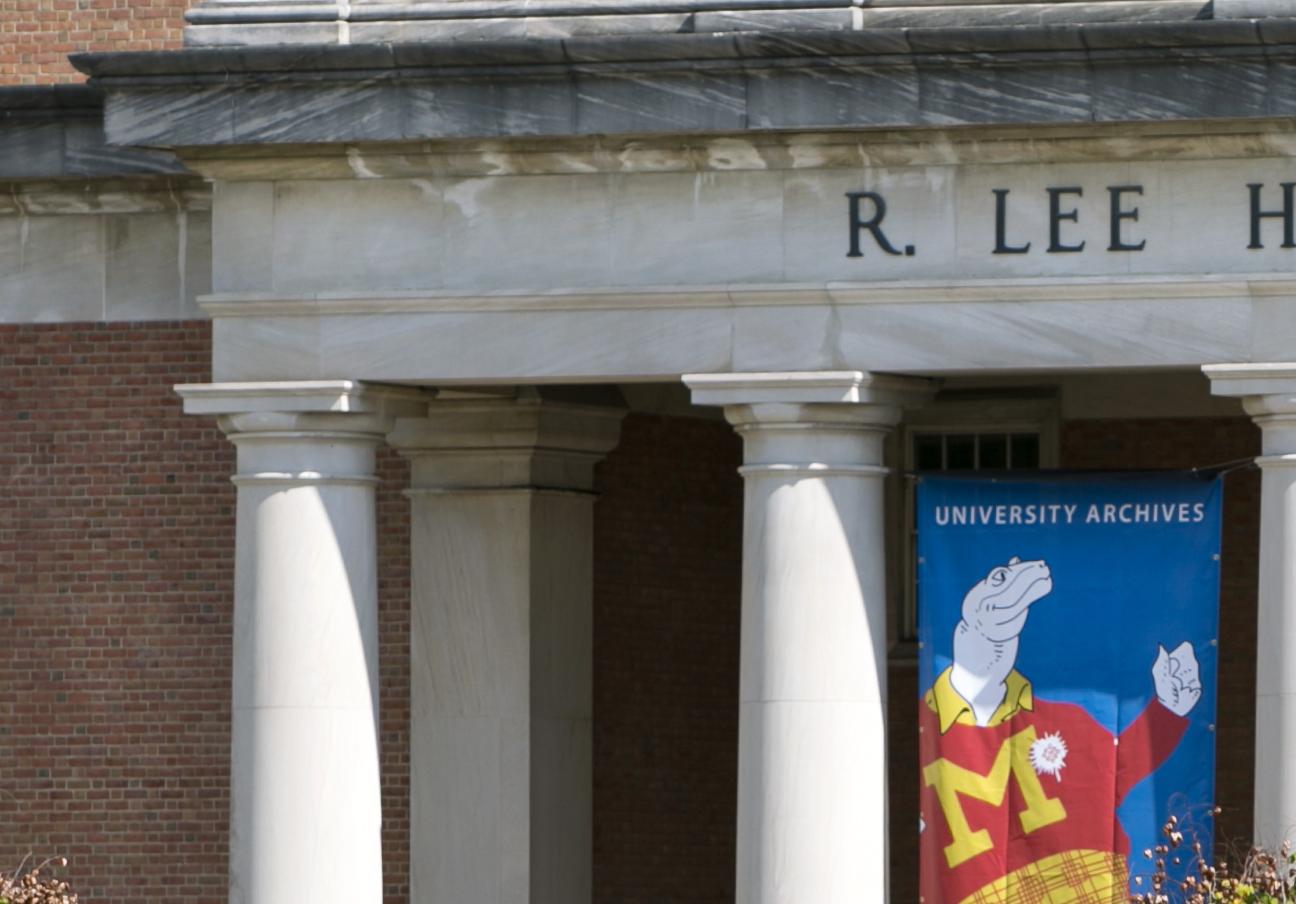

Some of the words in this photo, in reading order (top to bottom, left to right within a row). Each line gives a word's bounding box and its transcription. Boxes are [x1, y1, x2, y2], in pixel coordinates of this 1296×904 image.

[845, 190, 915, 257] R.
[992, 185, 1145, 254] LEE
[936, 506, 1075, 524] UNIVERSITY
[1087, 504, 1203, 522] ARCHIVES
[923, 725, 1067, 867] M
